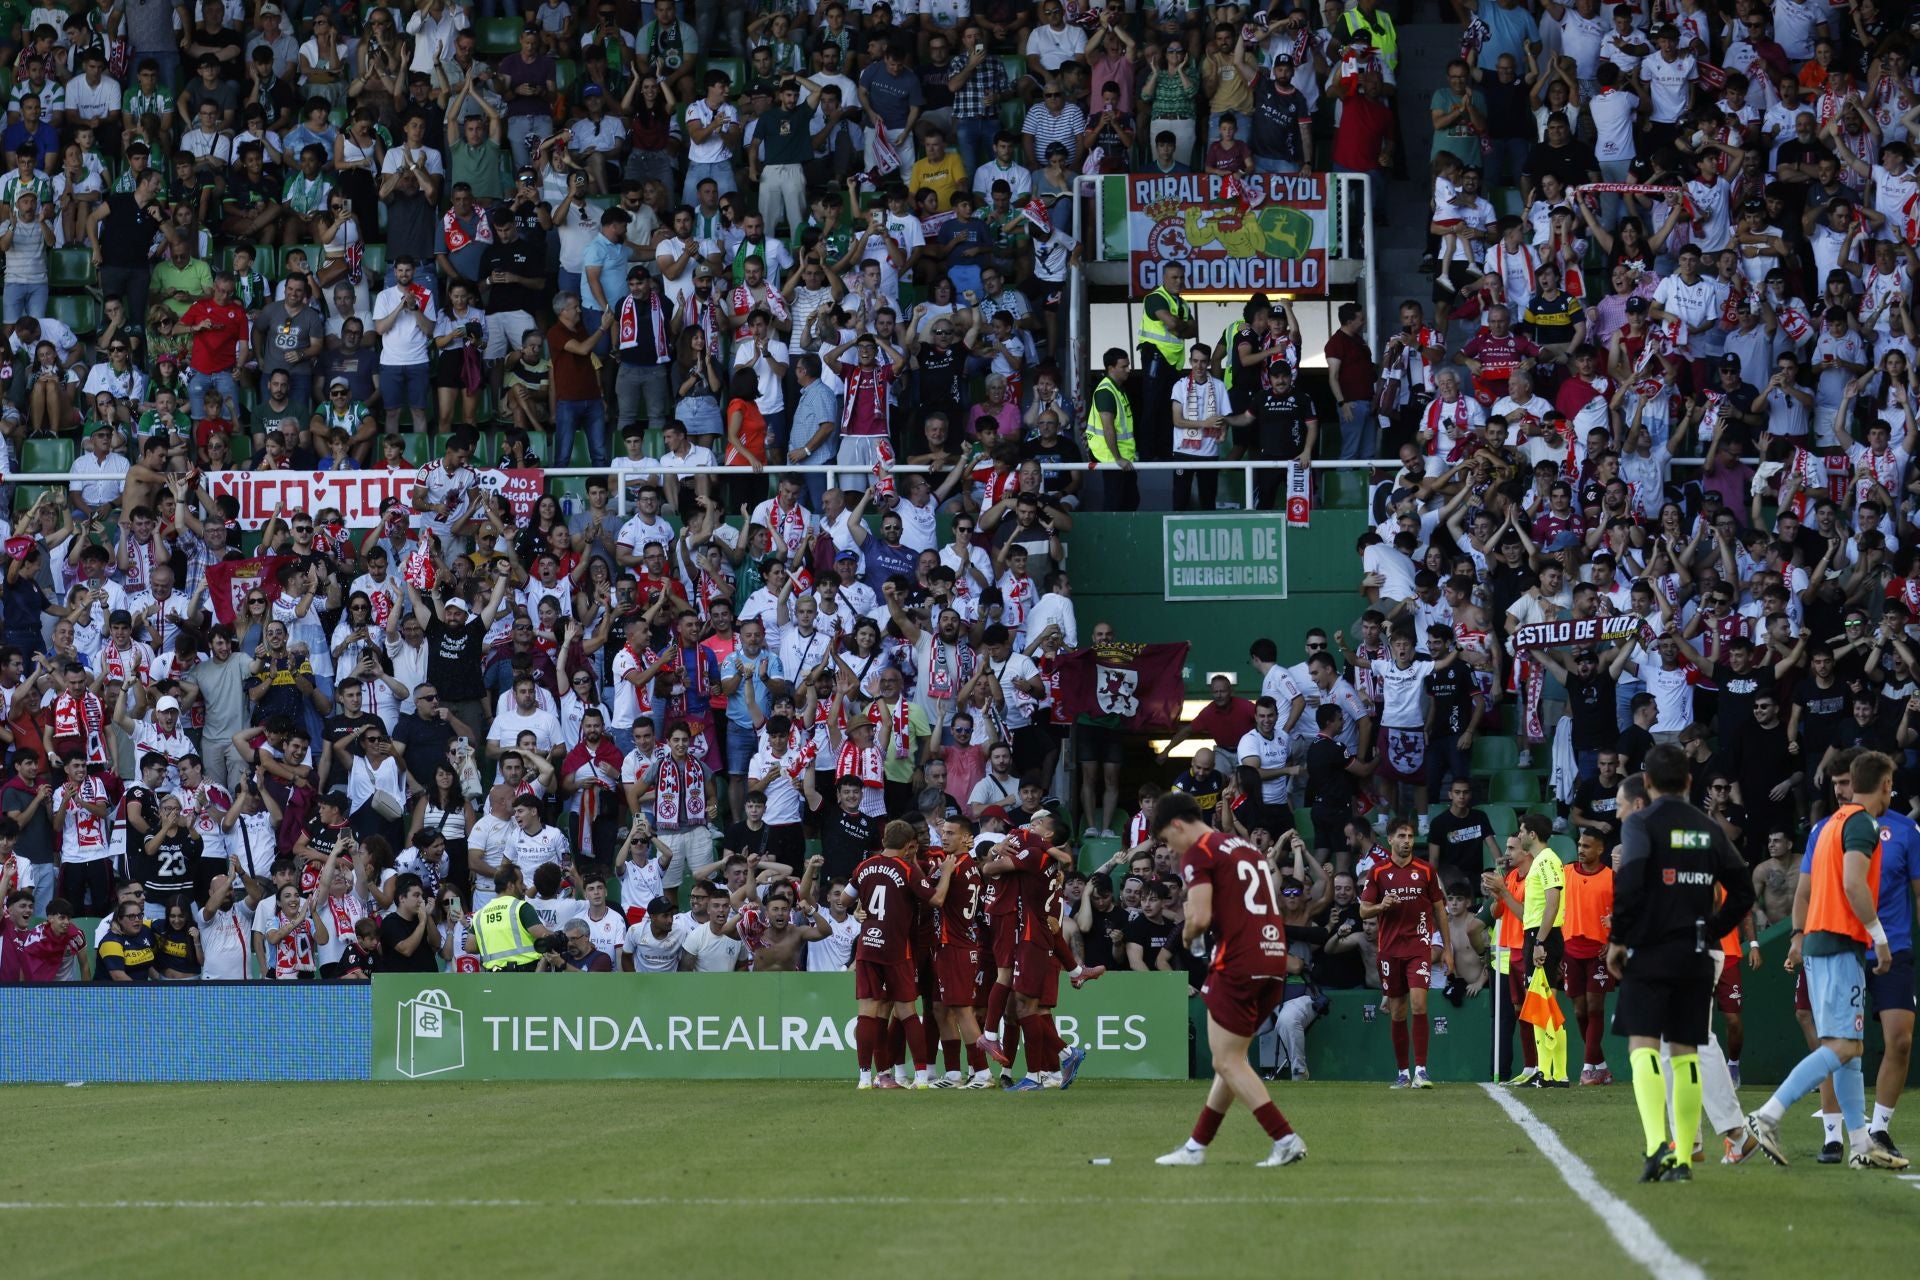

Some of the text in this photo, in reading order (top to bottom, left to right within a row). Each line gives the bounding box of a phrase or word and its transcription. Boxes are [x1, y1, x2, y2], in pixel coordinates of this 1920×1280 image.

[1136, 176, 1322, 204] RURAL BS CYDL
[276, 335, 298, 348] 66
[1173, 527, 1277, 562] SALIDA DE
[1173, 566, 1278, 586] EMERGENCIAS
[1517, 616, 1640, 646] ESTILO DE VIDA
[1671, 831, 1710, 847] BKT
[157, 851, 187, 877] 23
[878, 865, 905, 889] SUÁREZ
[1237, 860, 1279, 916] 21
[869, 884, 887, 921] 4
[1385, 887, 1422, 896] ASPIRE
[486, 912, 502, 924] 195
